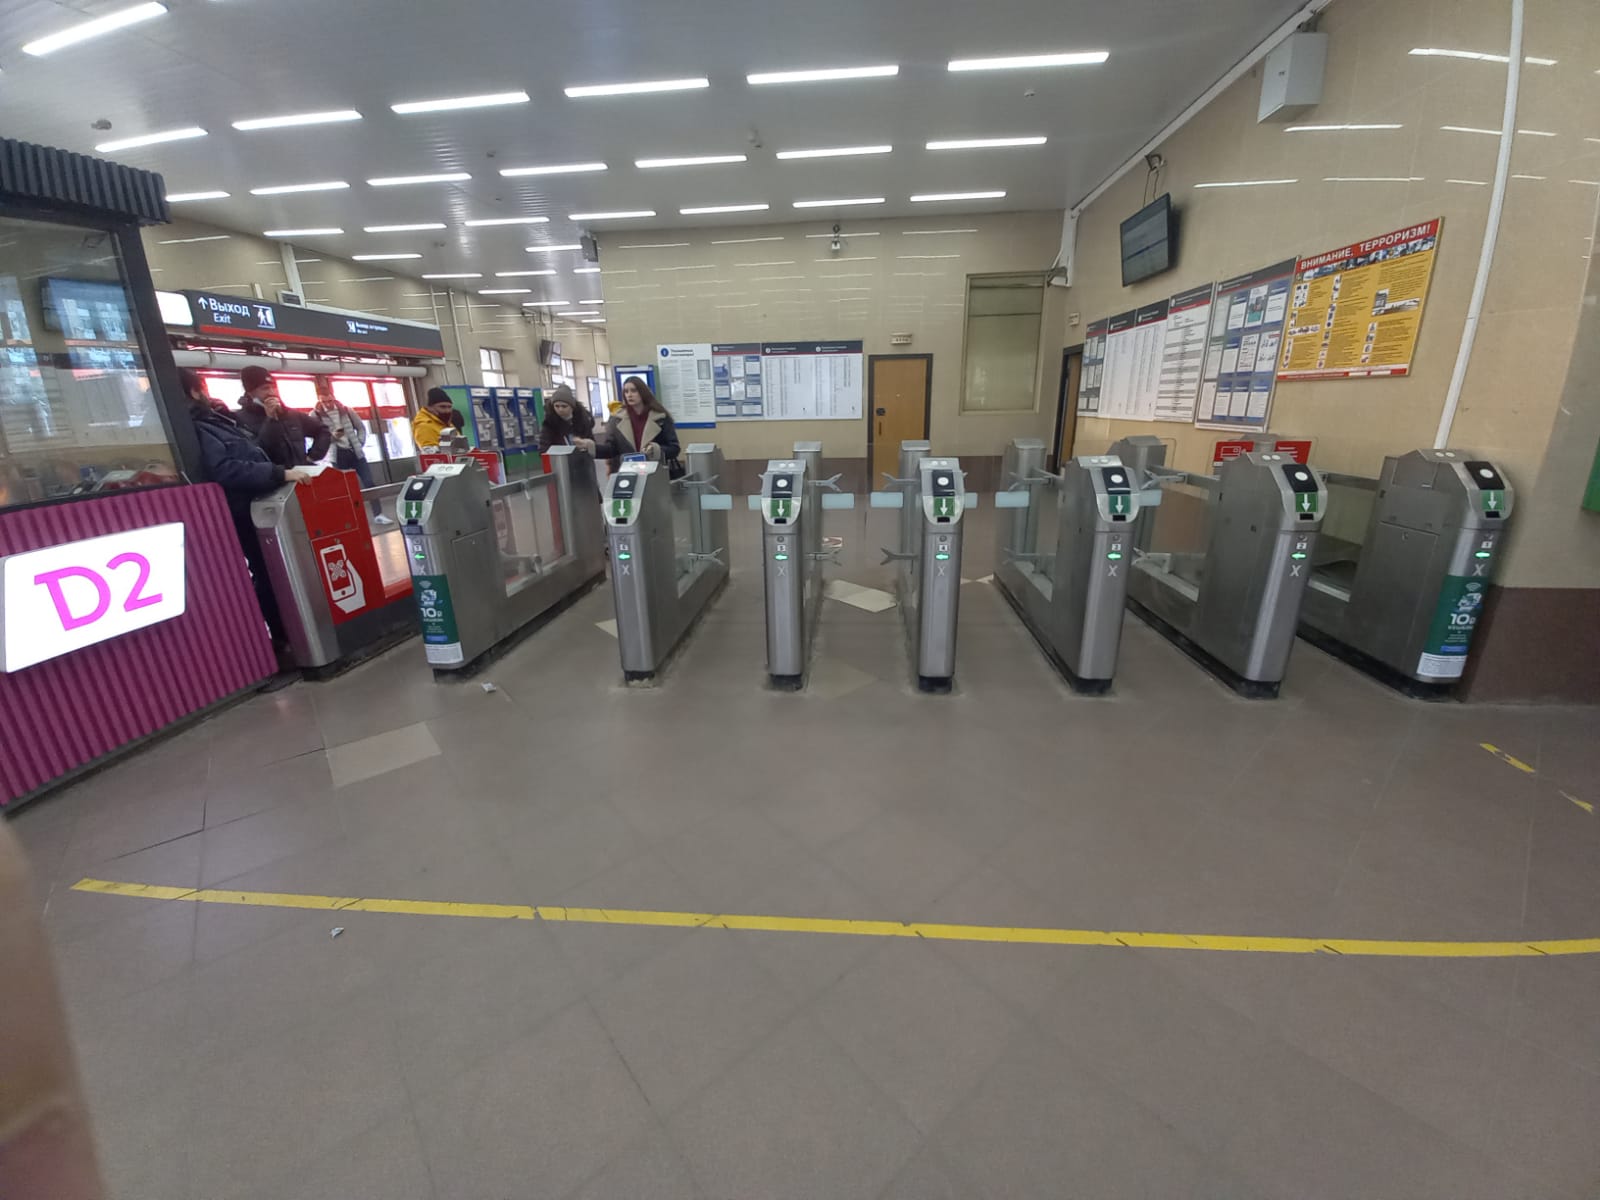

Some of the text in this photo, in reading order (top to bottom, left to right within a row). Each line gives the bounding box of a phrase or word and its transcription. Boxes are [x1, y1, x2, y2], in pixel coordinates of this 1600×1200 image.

[1360, 223, 1430, 251] ТЕРРОРИЗМ!
[208, 297, 250, 317] Выход
[213, 313, 232, 324] Exit
[34, 552, 163, 631] D2
